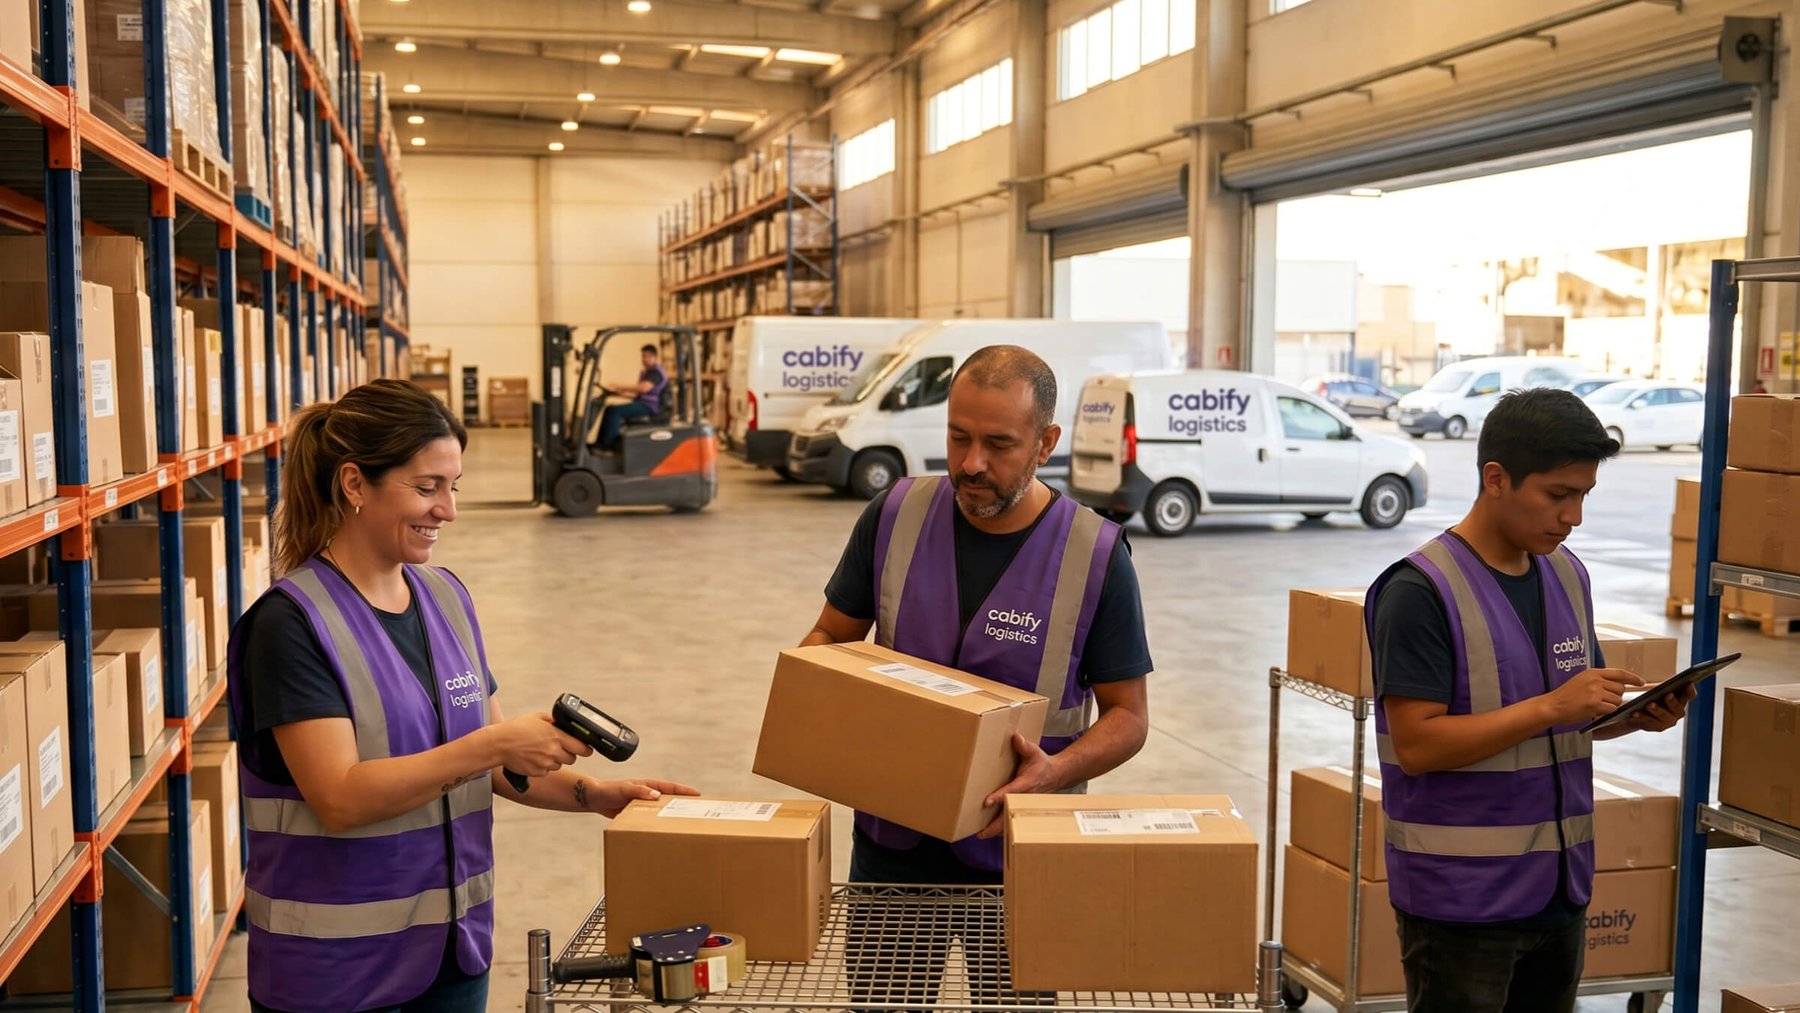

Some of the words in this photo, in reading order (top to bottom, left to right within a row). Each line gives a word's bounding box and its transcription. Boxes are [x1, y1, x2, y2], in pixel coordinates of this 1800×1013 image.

[782, 344, 864, 372] cabify
[1168, 388, 1251, 416] cabify
[1168, 415, 1247, 436] logistics
[988, 609, 1042, 632] cabify
[984, 622, 1038, 645] logistics
[1553, 635, 1585, 654] cabify
[1585, 931, 1630, 950] gistics
